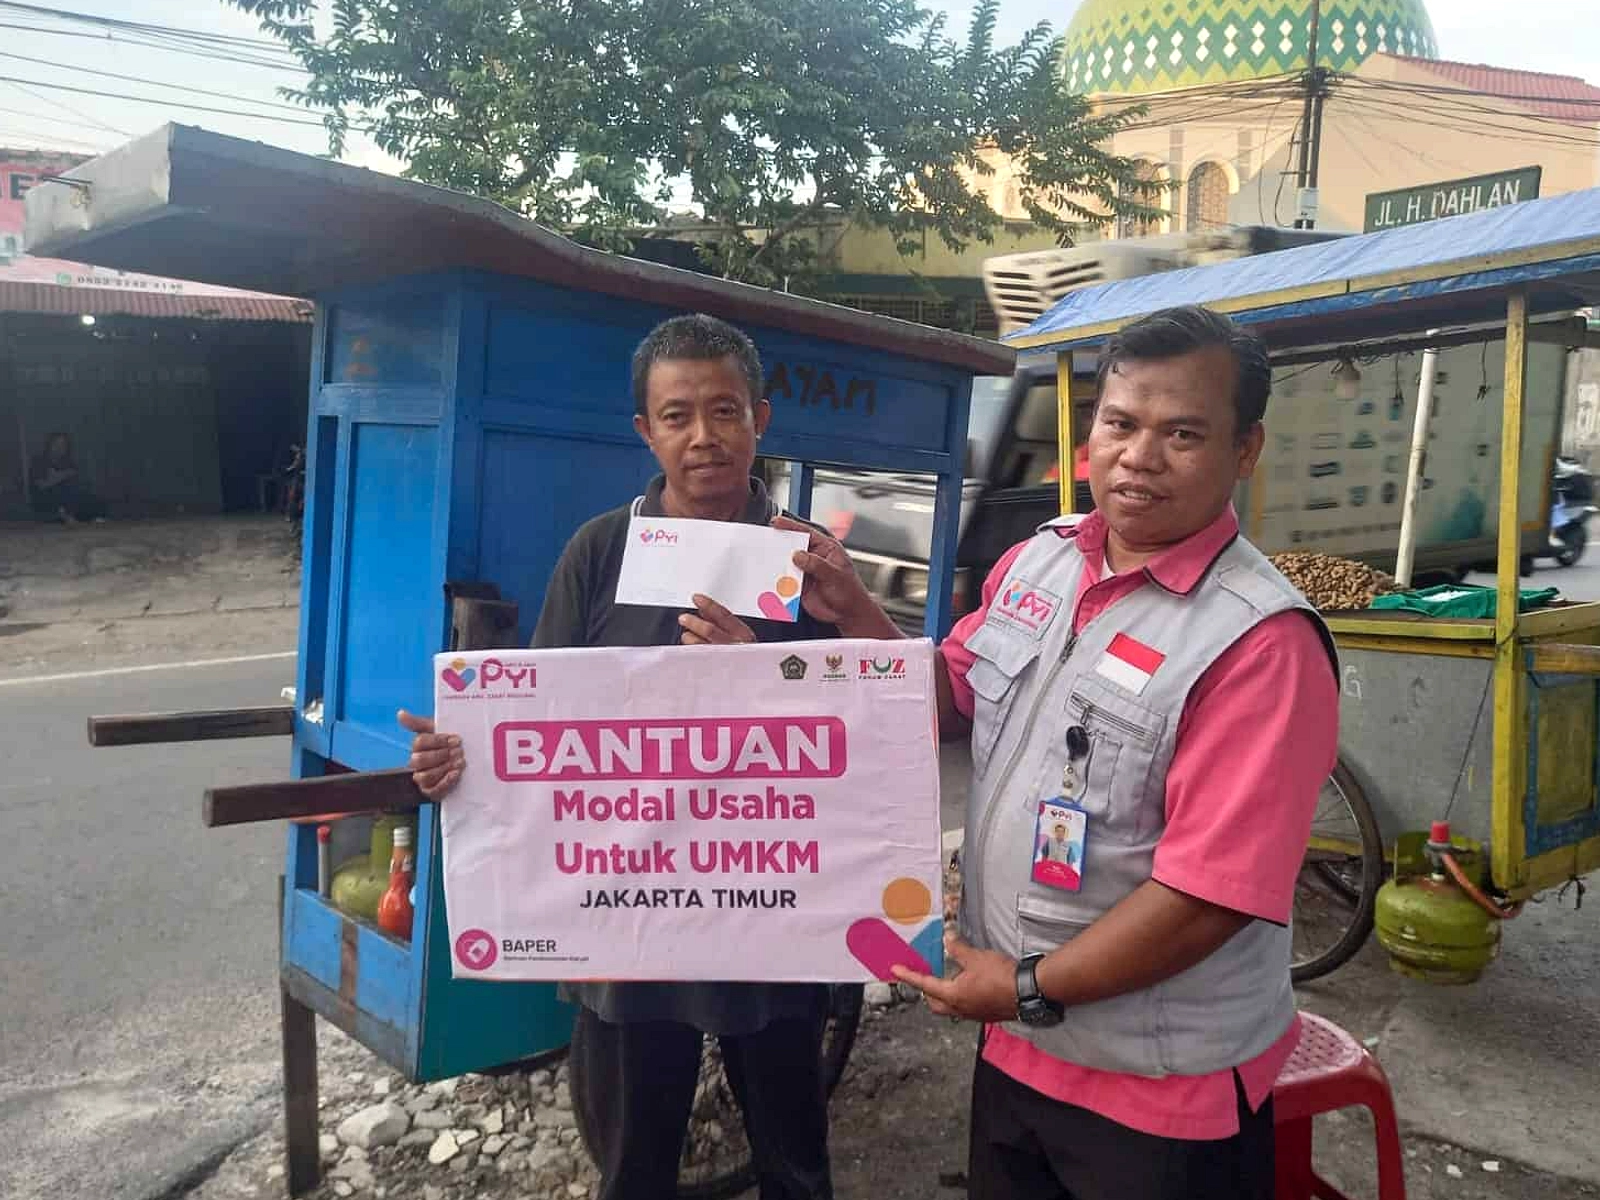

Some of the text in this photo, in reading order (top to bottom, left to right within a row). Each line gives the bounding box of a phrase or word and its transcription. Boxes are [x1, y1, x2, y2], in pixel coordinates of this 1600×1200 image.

[1375, 179, 1520, 226] JL. H. DAHLAN
[481, 658, 537, 689] PYI
[505, 724, 831, 776] BANTUAN
[553, 786, 815, 823] Modal Usaha
[555, 840, 819, 876] Untuk UMKM
[580, 888, 797, 909] JAKARTA TIMUR
[502, 939, 557, 953] BAPER
